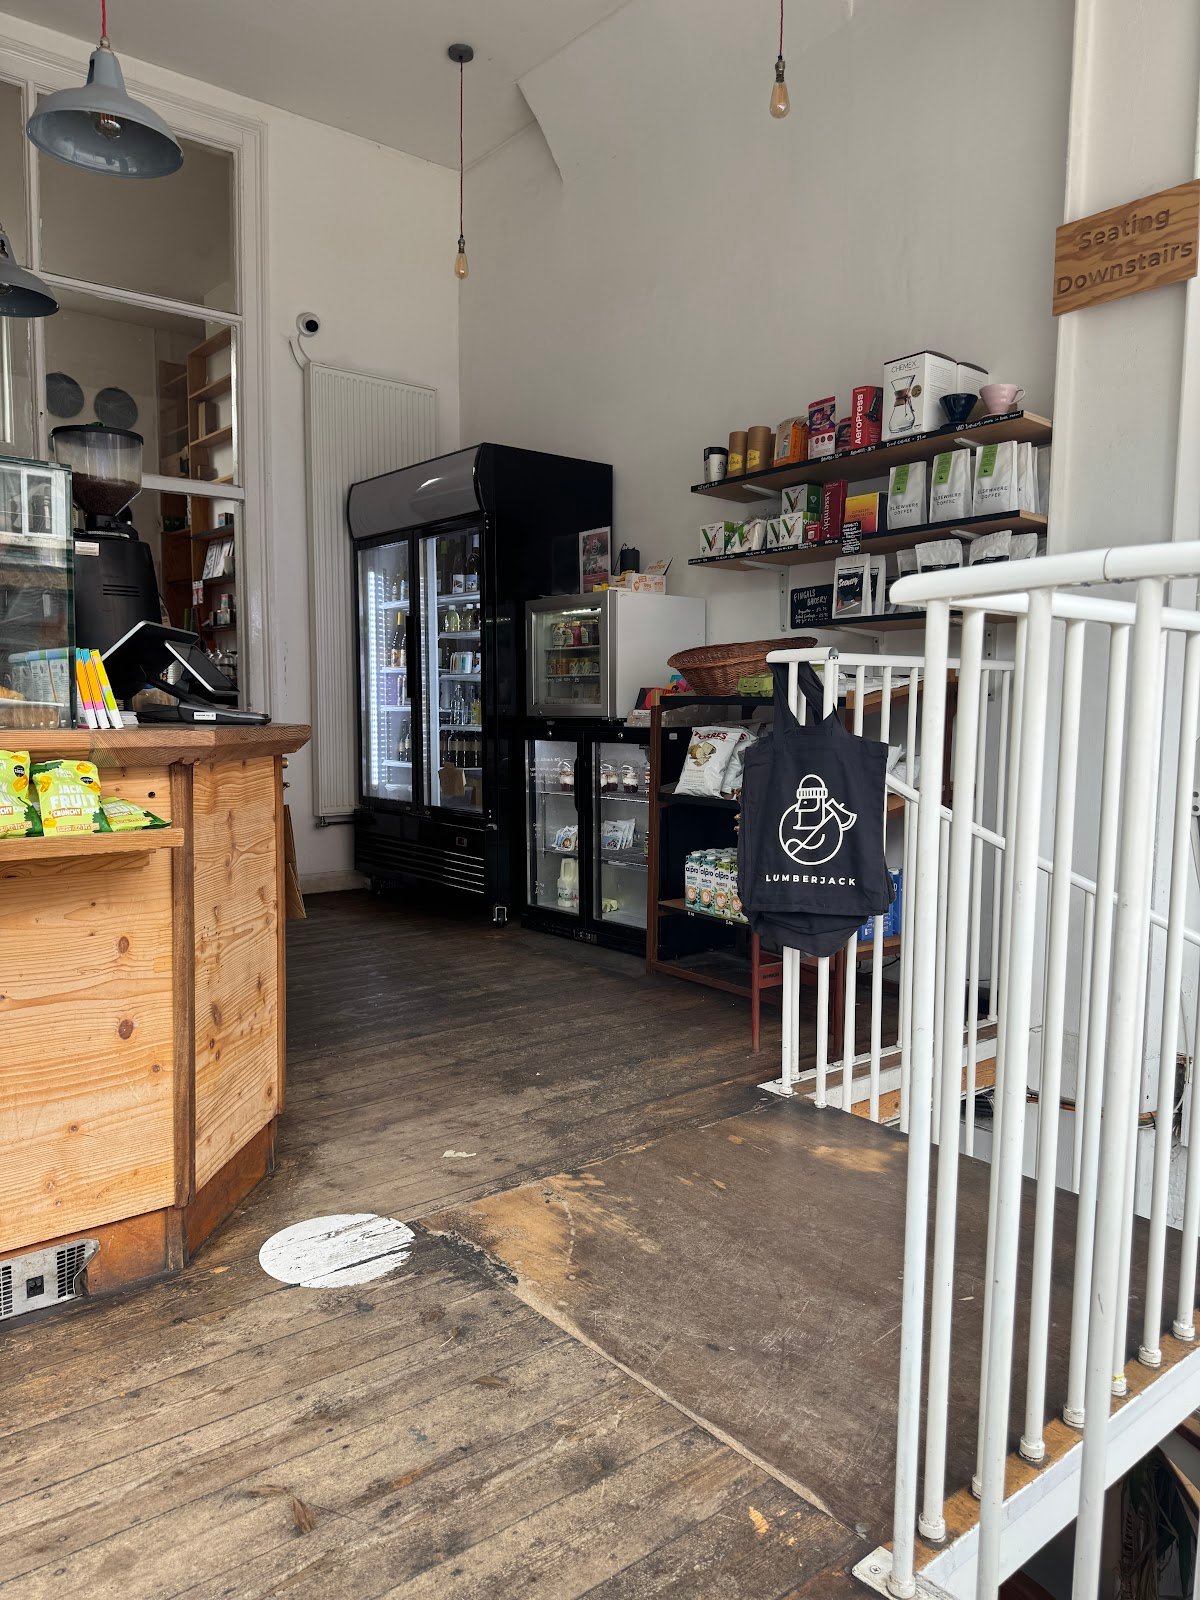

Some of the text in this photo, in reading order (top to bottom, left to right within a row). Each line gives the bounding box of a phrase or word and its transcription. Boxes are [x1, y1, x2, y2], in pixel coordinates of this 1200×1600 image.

[1078, 208, 1170, 251] Seating
[1056, 241, 1193, 296] Downstairs
[891, 361, 918, 374] CHEMEX
[854, 393, 864, 445] AeroPress
[822, 491, 832, 532] Assembly
[693, 730, 729, 741] TORRES
[58, 784, 84, 794] JACK
[50, 794, 97, 810] FRUIT
[52, 808, 82, 818] CRUNCHY
[685, 865, 699, 875] alpro
[700, 867, 714, 877] alpro
[714, 871, 729, 881] alpro
[765, 873, 857, 886] LUMBERJACK
